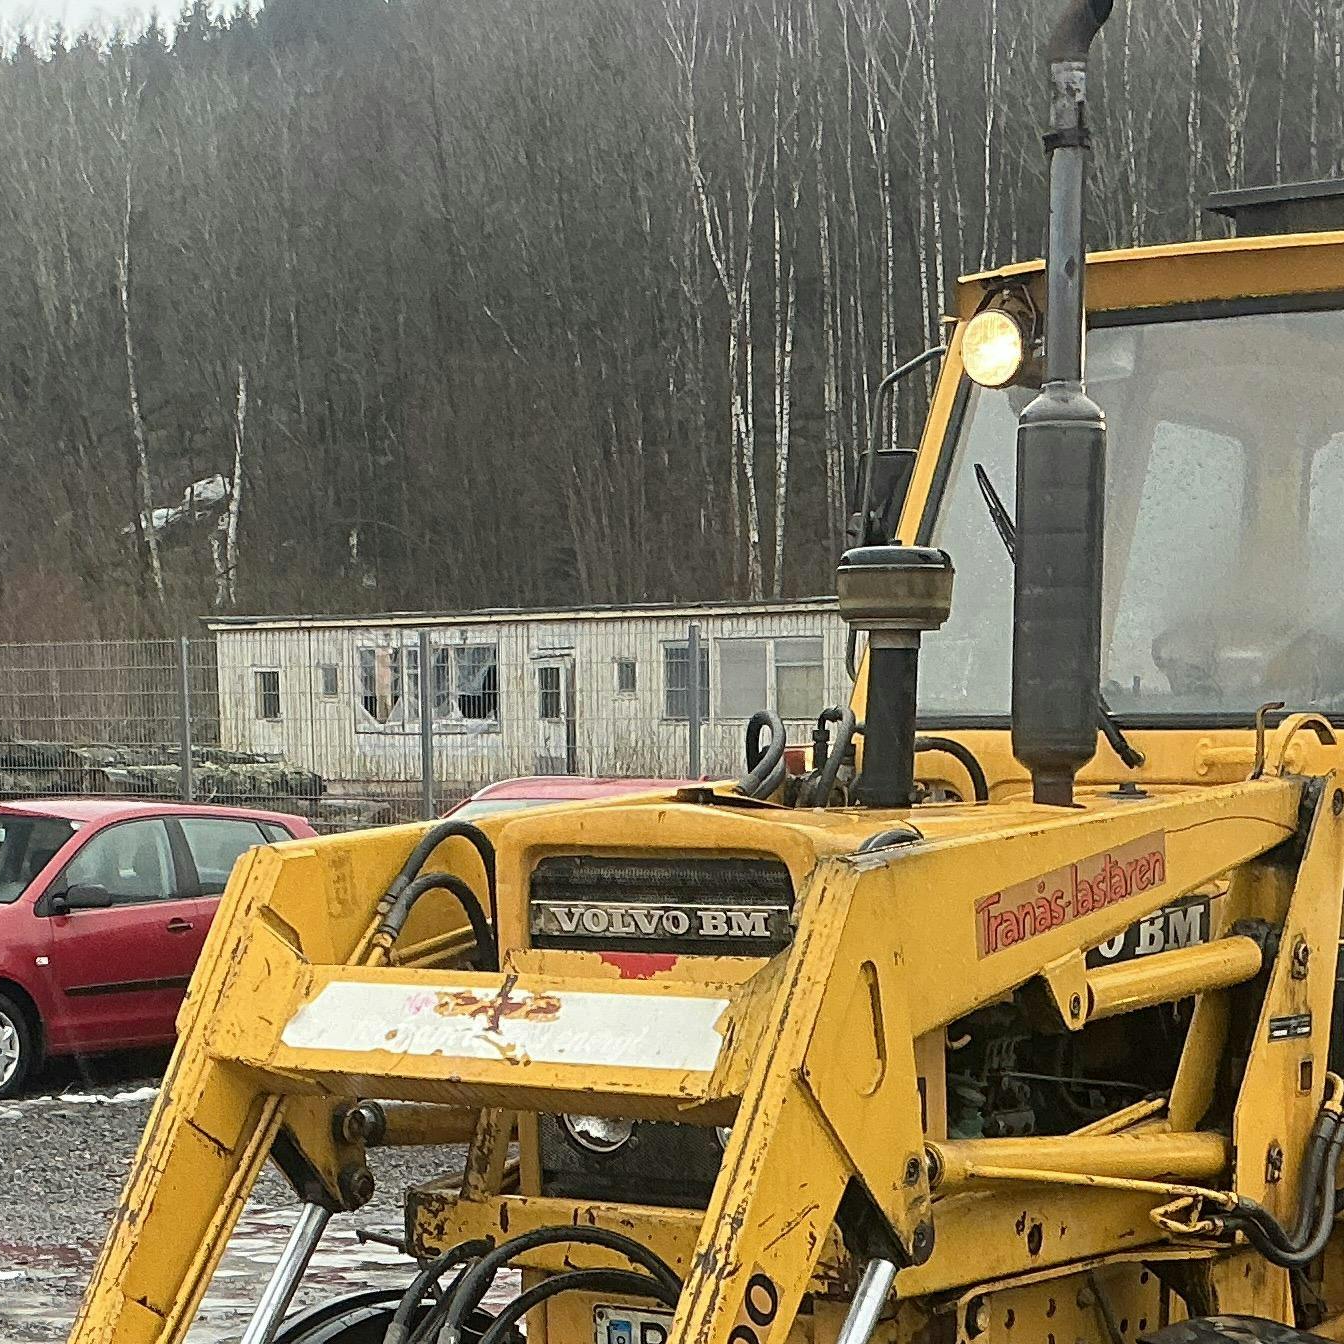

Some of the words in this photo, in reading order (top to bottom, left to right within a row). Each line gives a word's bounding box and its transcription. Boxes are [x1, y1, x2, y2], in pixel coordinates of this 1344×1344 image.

[550, 907, 690, 936] VOLVO
[696, 911, 771, 938] BM
[1135, 904, 1205, 956] BM
